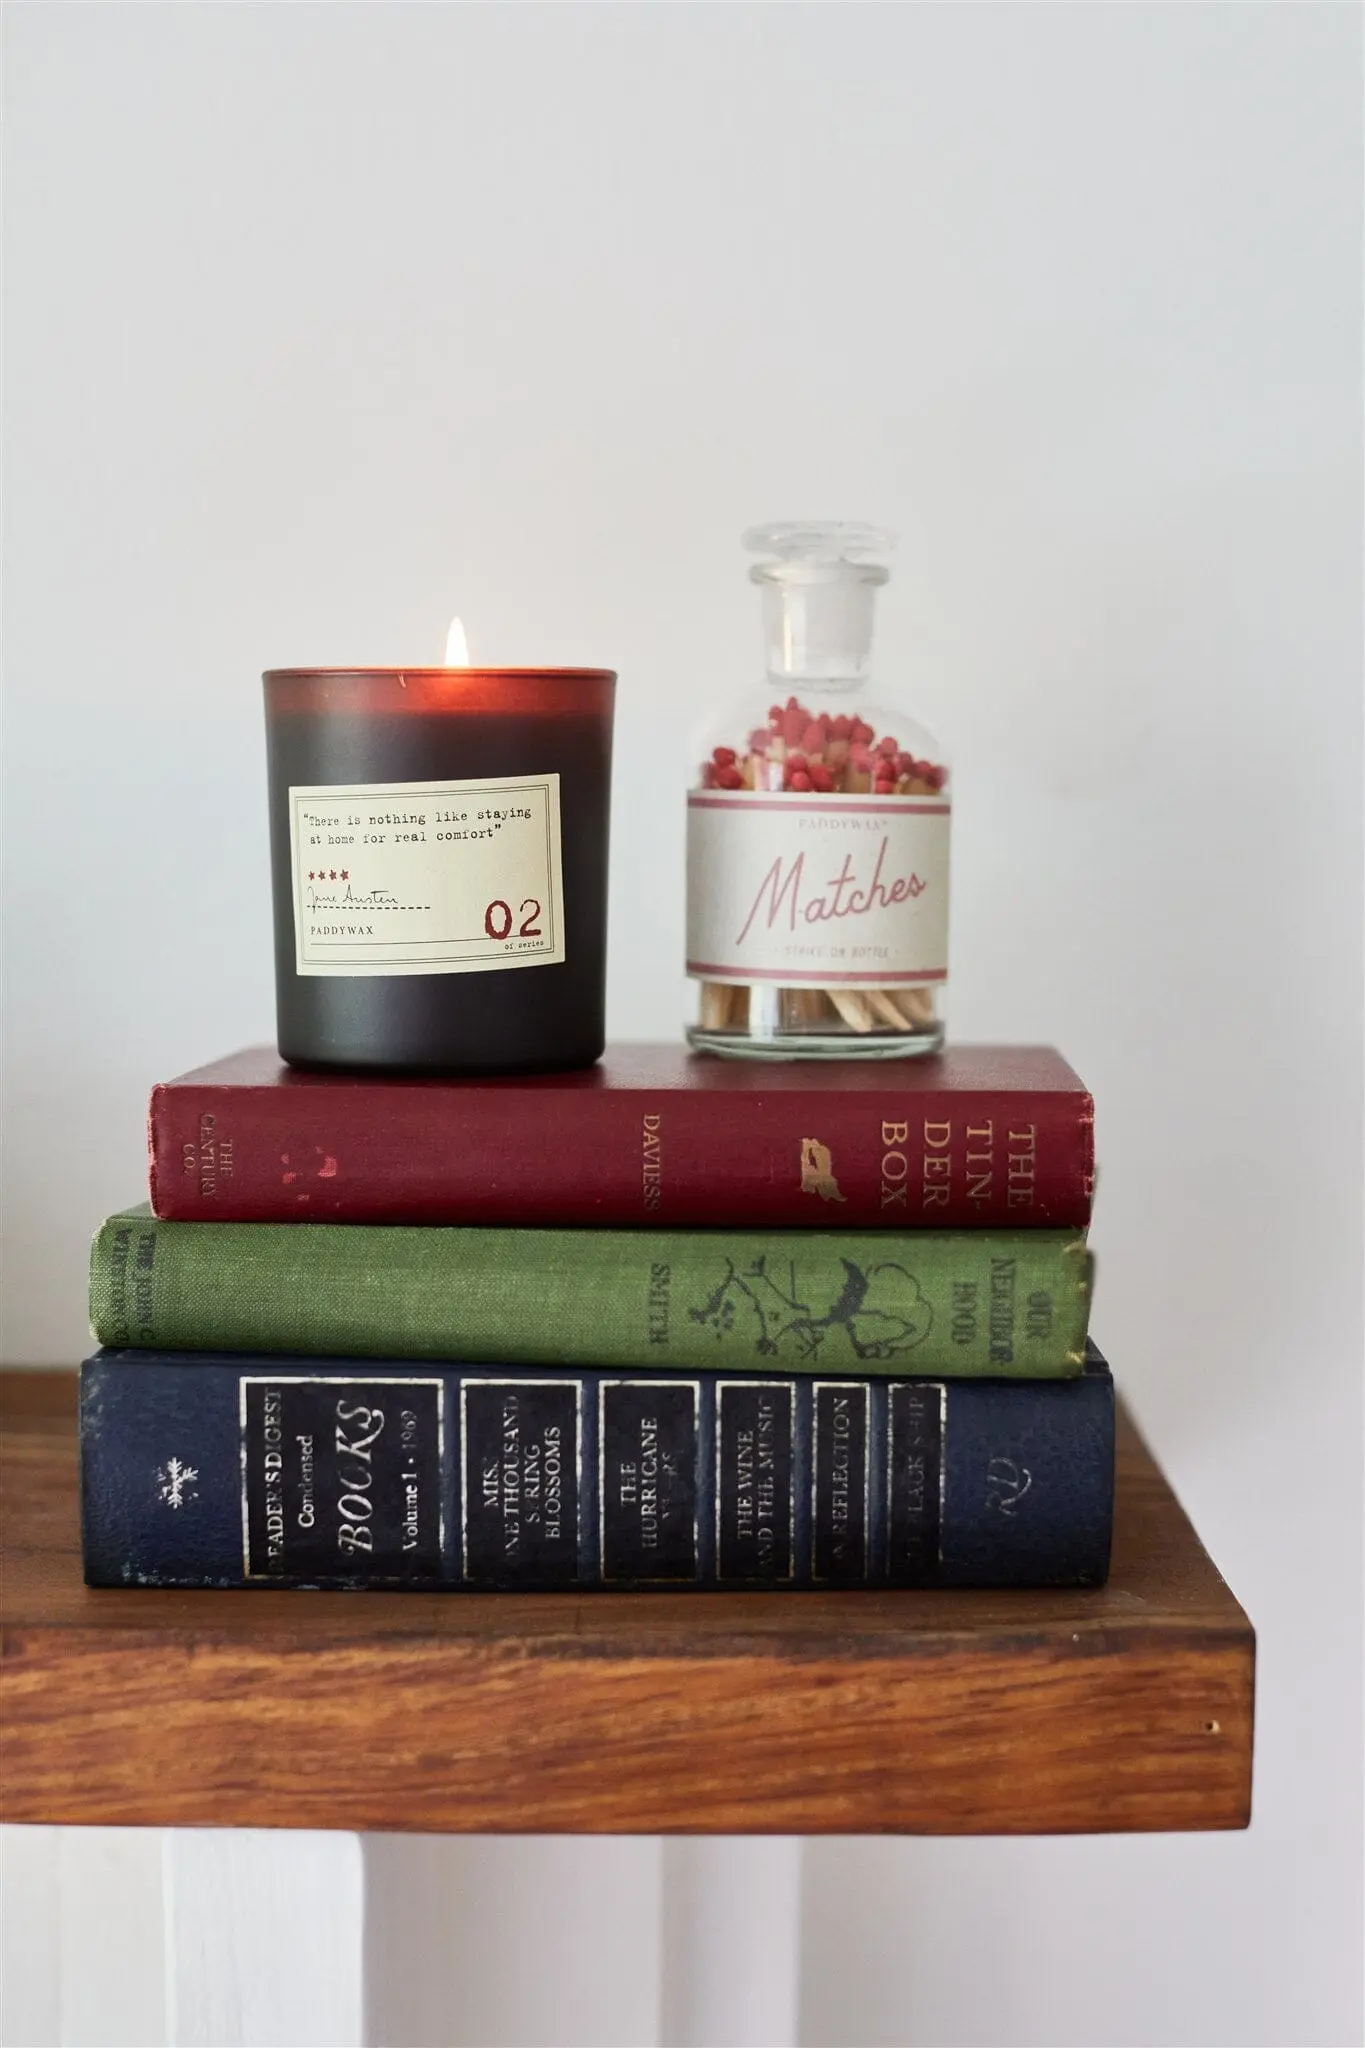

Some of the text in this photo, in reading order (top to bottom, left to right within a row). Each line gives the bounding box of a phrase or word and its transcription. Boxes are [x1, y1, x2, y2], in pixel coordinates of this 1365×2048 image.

[310, 834, 322, 845] at
[328, 833, 355, 845] home
[363, 832, 386, 845] for
[394, 831, 427, 843] real
[348, 815, 361, 826] is
[369, 812, 426, 827] nothing
[436, 810, 468, 823] like
[477, 807, 532, 823] staying
[307, 884, 399, 914] Jane Austen
[310, 925, 374, 936] PADDYWAX
[484, 898, 542, 941] 02
[735, 836, 928, 946] Matches
[504, 941, 545, 952] of series
[199, 1113, 217, 1197] CENTURY
[219, 1138, 234, 1177] THE
[642, 1113, 662, 1213] DAVIESS
[880, 1119, 909, 1209] BOX
[922, 1118, 952, 1210] DER
[1006, 1124, 1036, 1210] THE
[295, 1433, 316, 1529] Condensed
[523, 1444, 541, 1524] SRING
[620, 1460, 637, 1508] THE
[640, 1416, 658, 1548] HURRICANE
[737, 1428, 754, 1540] THE WINE
[831, 1396, 851, 1537] REFLECTION
[264, 1470, 284, 1572] EADER'S
[401, 1484, 419, 1552] Volume
